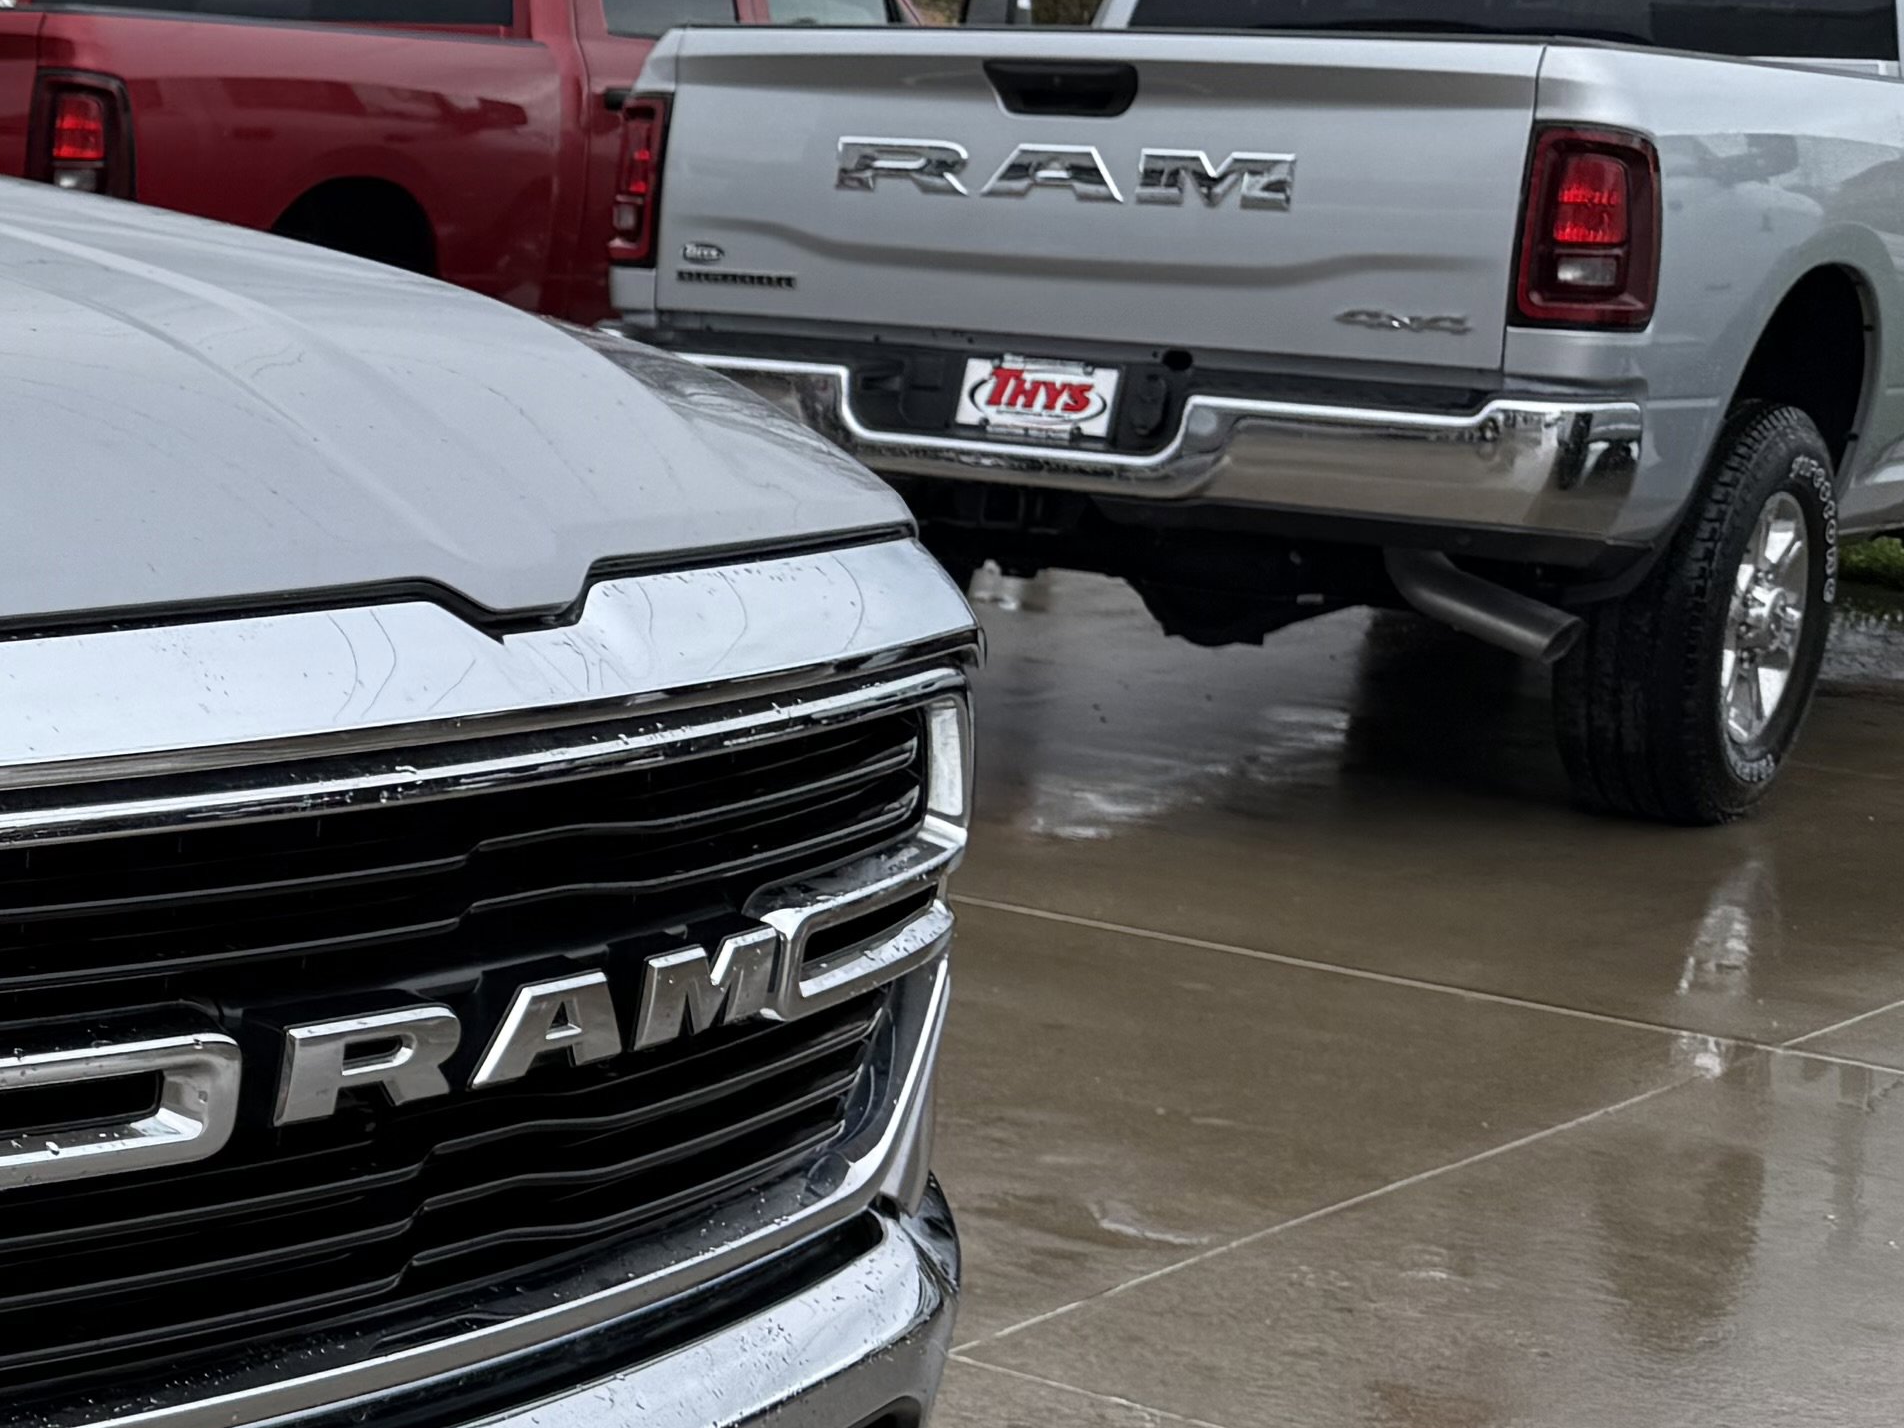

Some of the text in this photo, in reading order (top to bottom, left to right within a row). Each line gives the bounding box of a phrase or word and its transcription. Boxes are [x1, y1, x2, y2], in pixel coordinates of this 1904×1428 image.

[835, 135, 1296, 212] RAM
[986, 368, 1094, 413] THYS
[273, 925, 781, 1128] RAM
